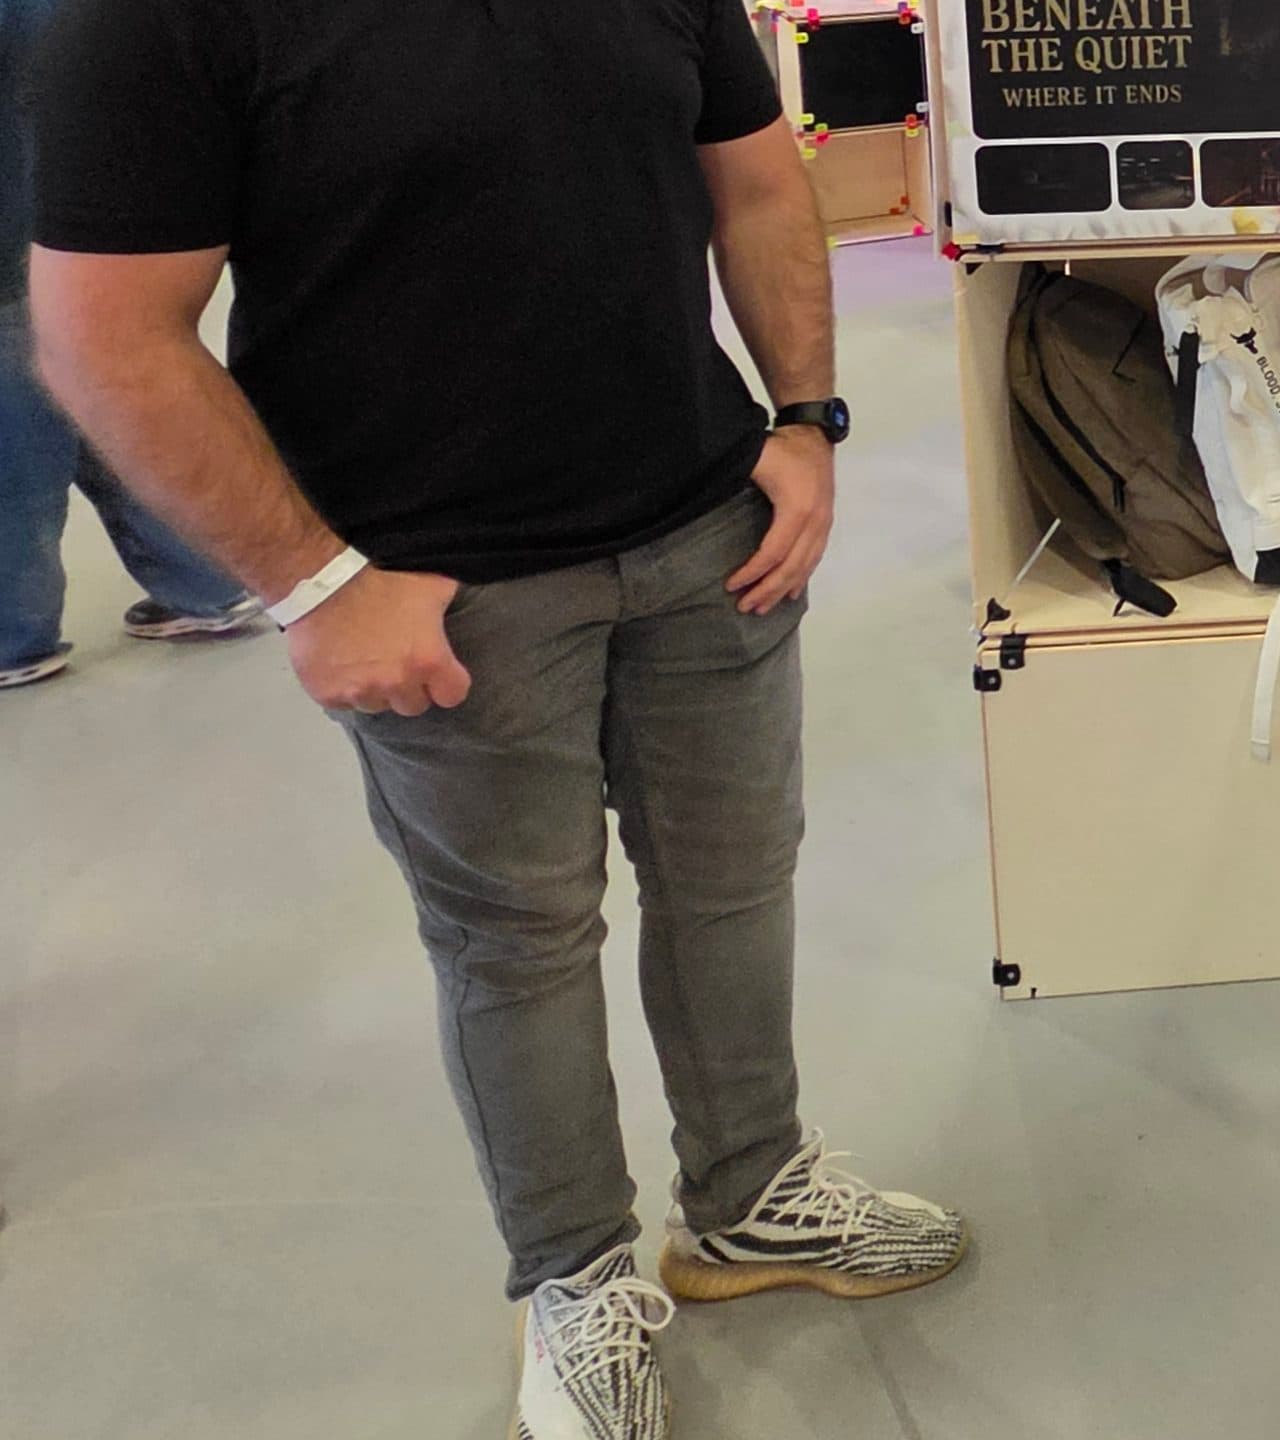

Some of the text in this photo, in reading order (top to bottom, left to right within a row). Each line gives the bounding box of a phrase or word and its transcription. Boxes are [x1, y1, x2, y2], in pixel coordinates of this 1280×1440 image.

[981, 34, 1193, 74] THE QUIET
[1002, 83, 1182, 108] WHERE IT ENDS
